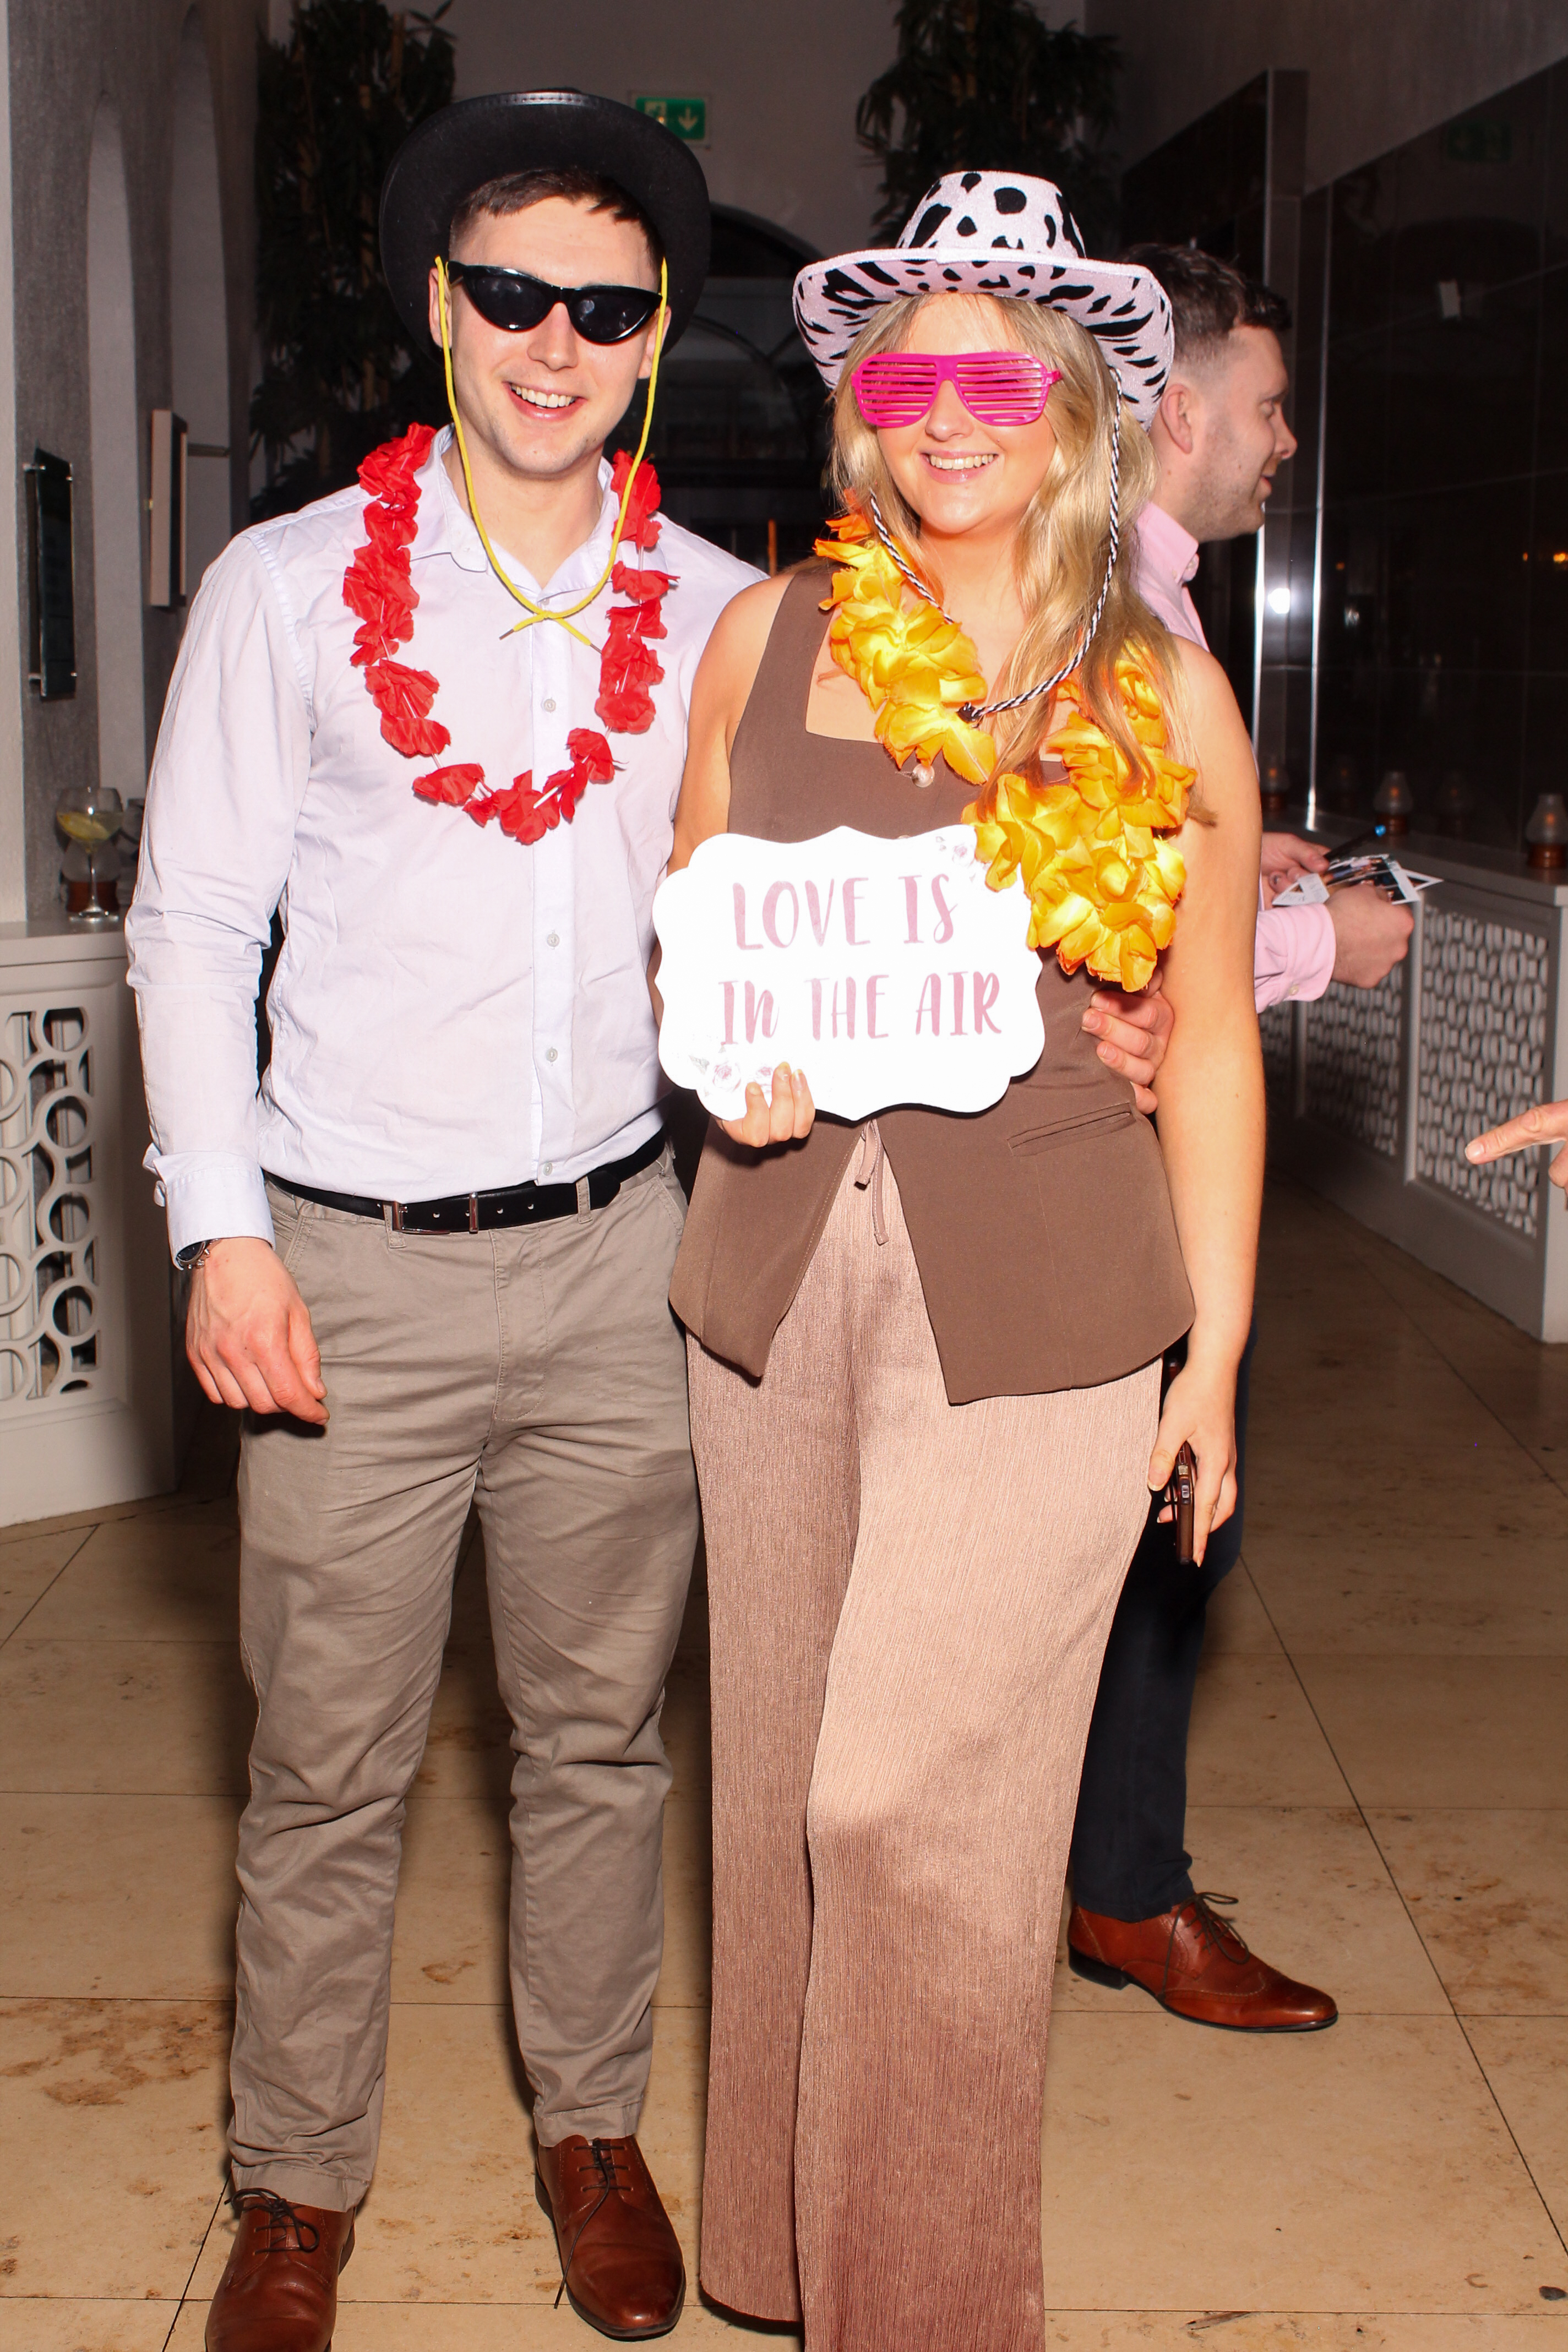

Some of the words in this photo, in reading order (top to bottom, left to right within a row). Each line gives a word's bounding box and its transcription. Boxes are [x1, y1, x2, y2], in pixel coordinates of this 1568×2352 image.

[733, 878, 871, 950] LOVE
[899, 874, 958, 944] IS
[805, 975, 890, 1041] THE
[915, 971, 1002, 1036] AIR
